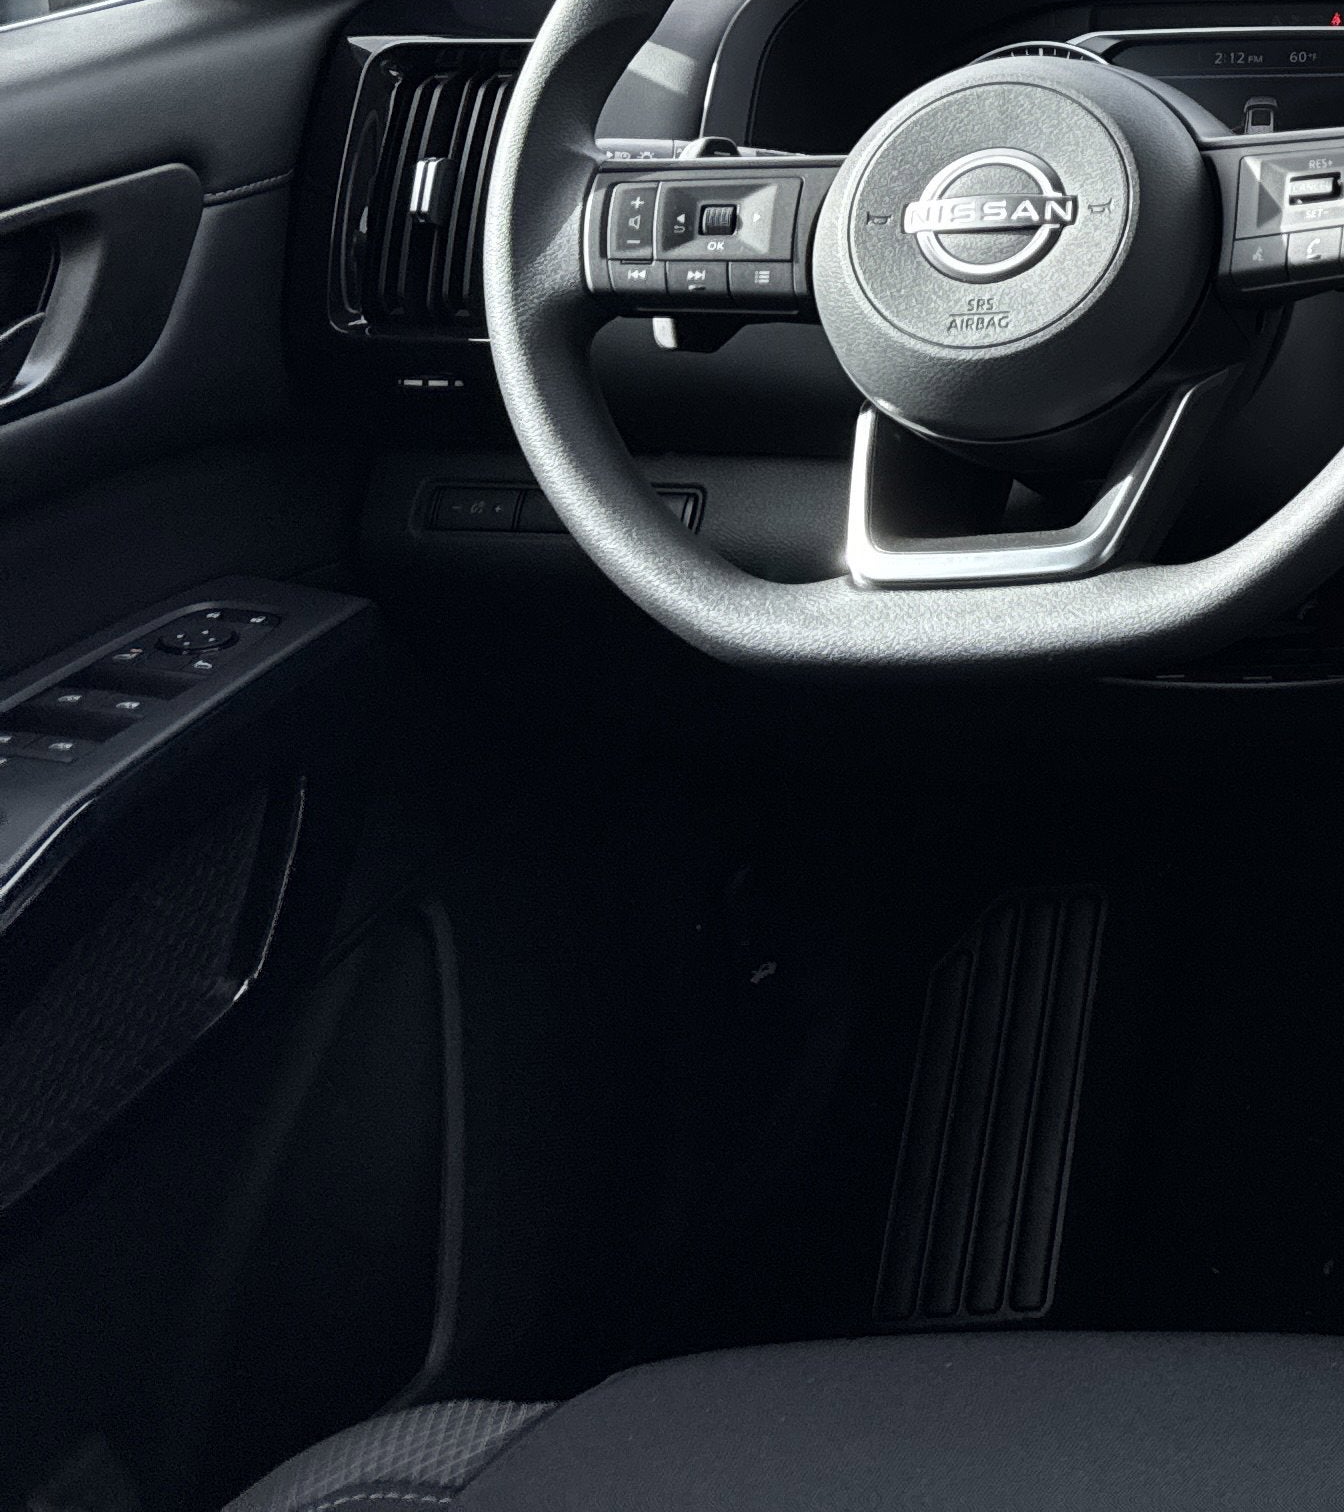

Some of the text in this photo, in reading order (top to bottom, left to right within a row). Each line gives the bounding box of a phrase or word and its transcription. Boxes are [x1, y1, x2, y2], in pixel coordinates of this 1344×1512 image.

[1214, 52, 1263, 65] 2:12 PM
[1309, 159, 1333, 168] RES+
[911, 199, 1073, 224] NISSAN
[707, 241, 725, 251] OK
[967, 298, 995, 312] SRS
[947, 316, 1010, 332] AIRBAG
